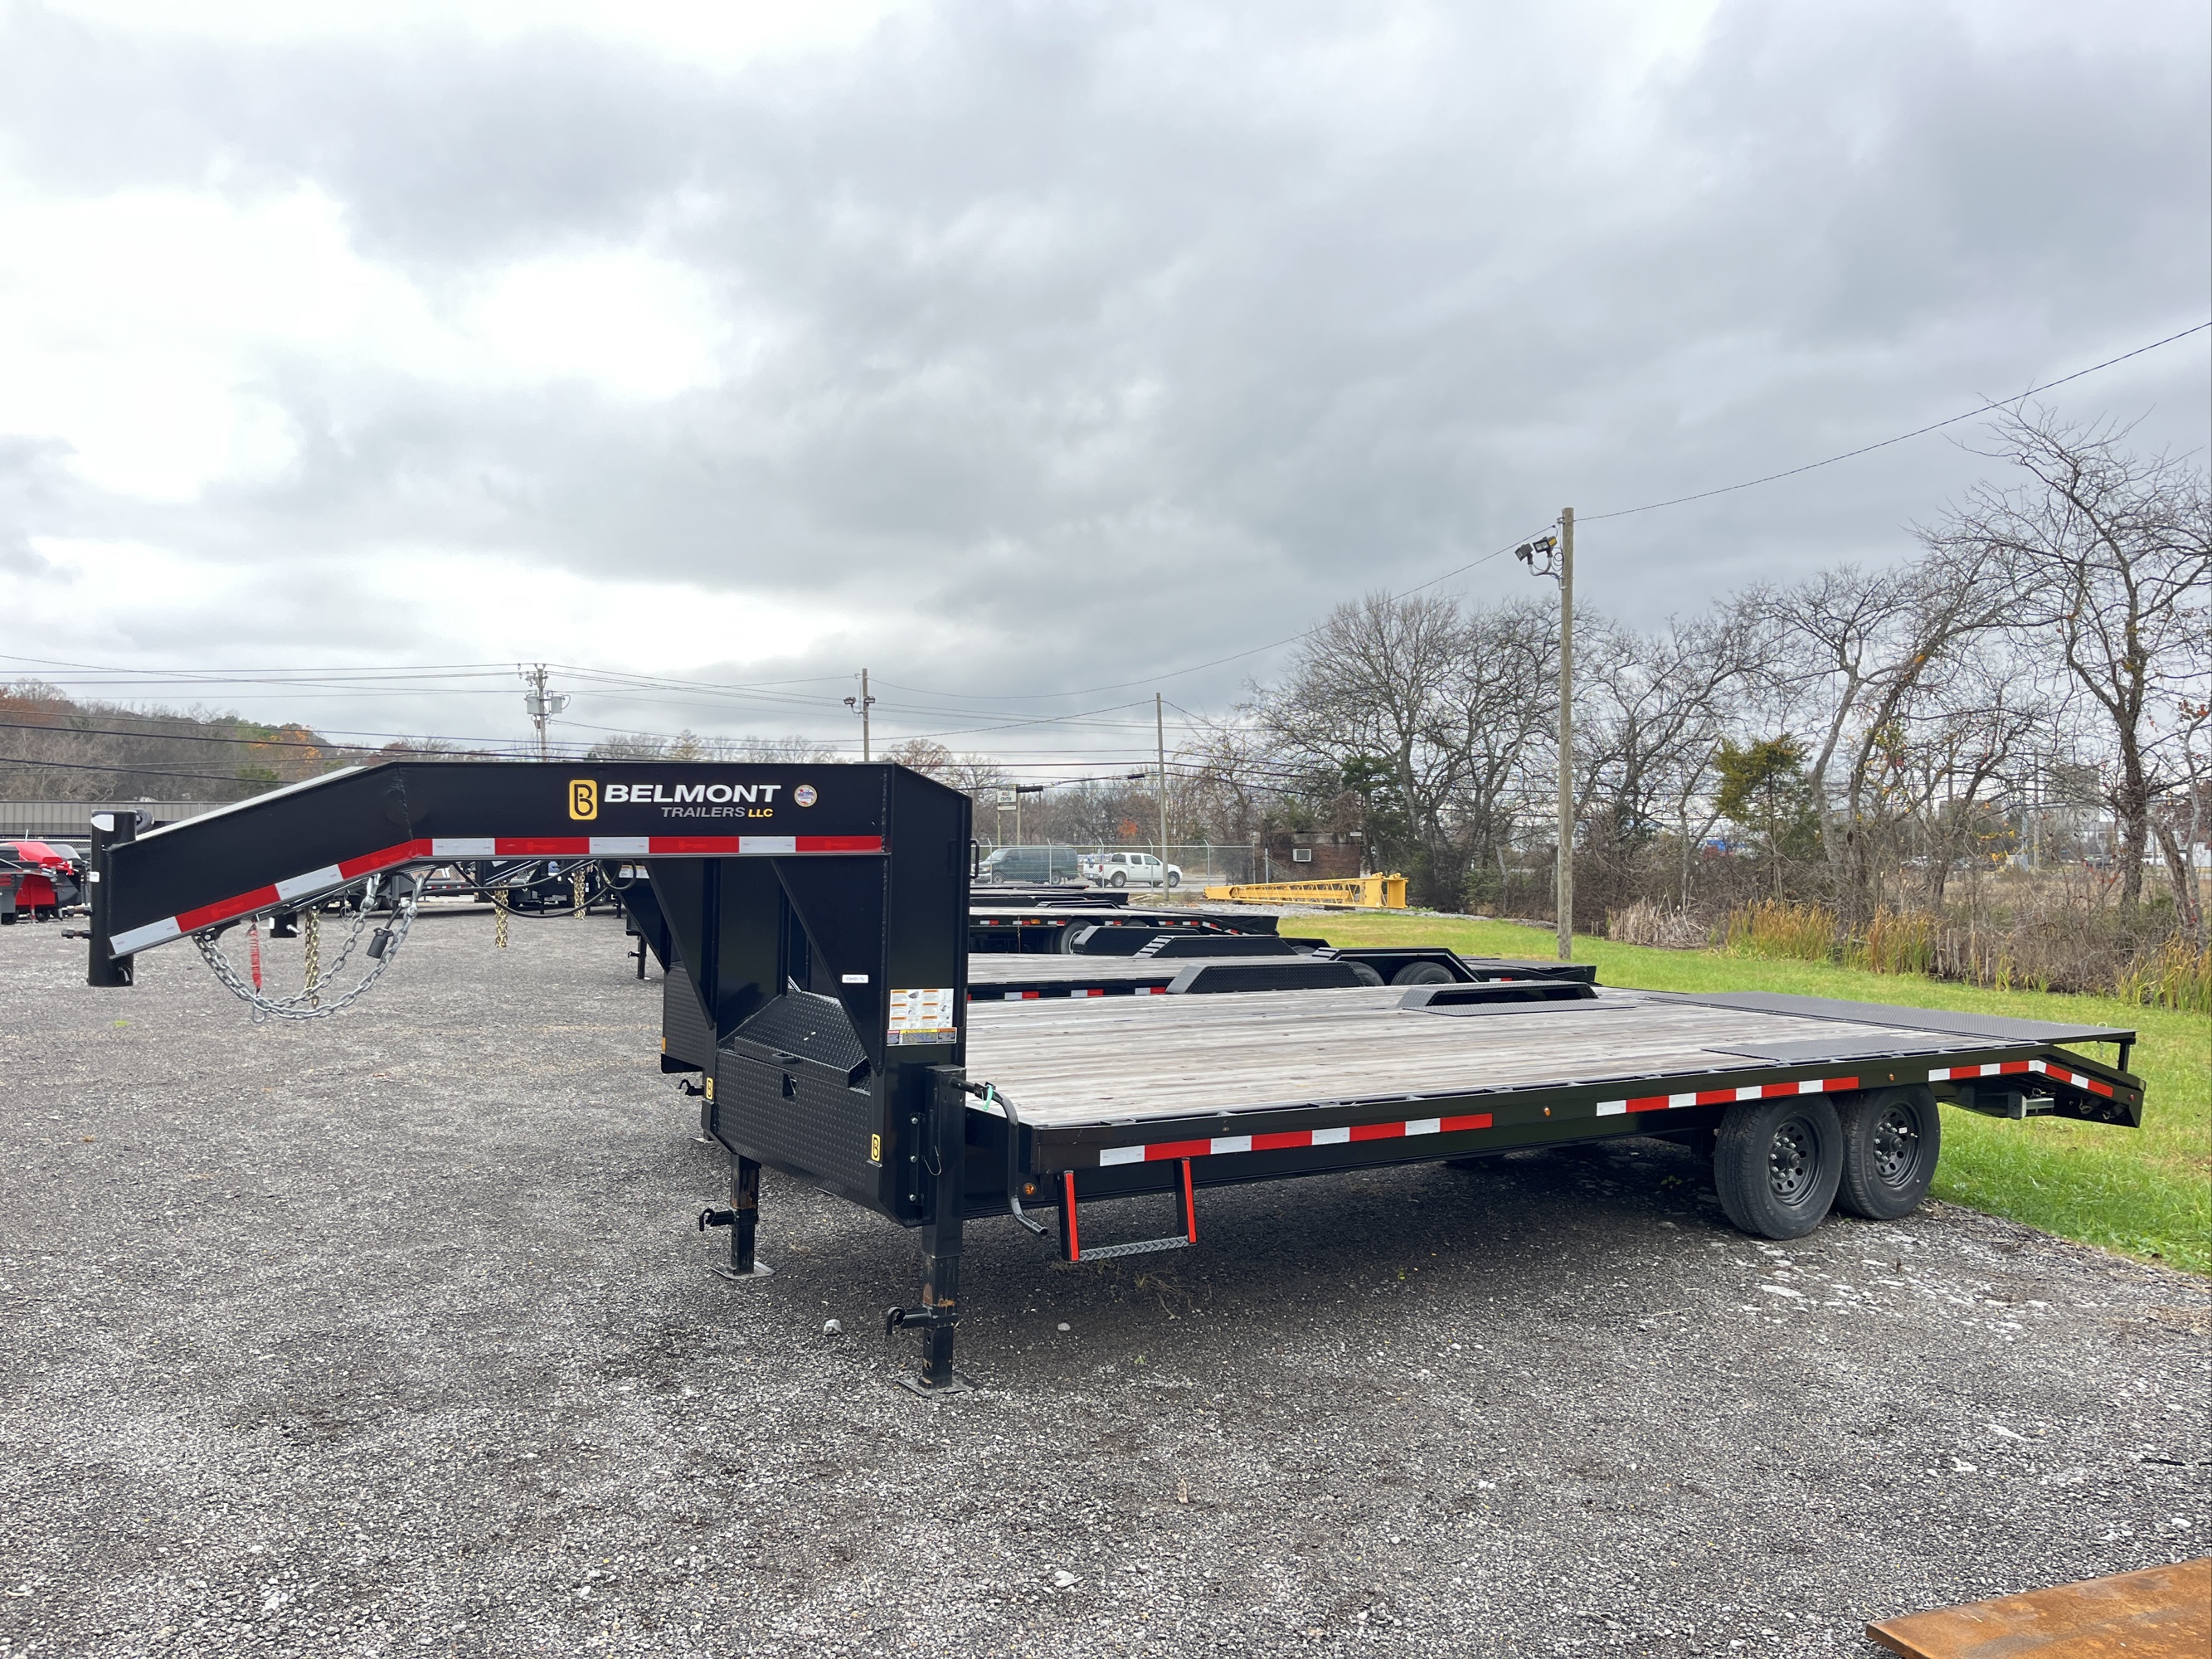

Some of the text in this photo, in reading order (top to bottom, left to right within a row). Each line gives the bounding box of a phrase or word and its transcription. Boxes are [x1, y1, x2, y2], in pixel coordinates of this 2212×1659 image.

[574, 784, 593, 816] B
[605, 784, 781, 803] BELMONT
[661, 806, 774, 818] TRAILERS LLC
